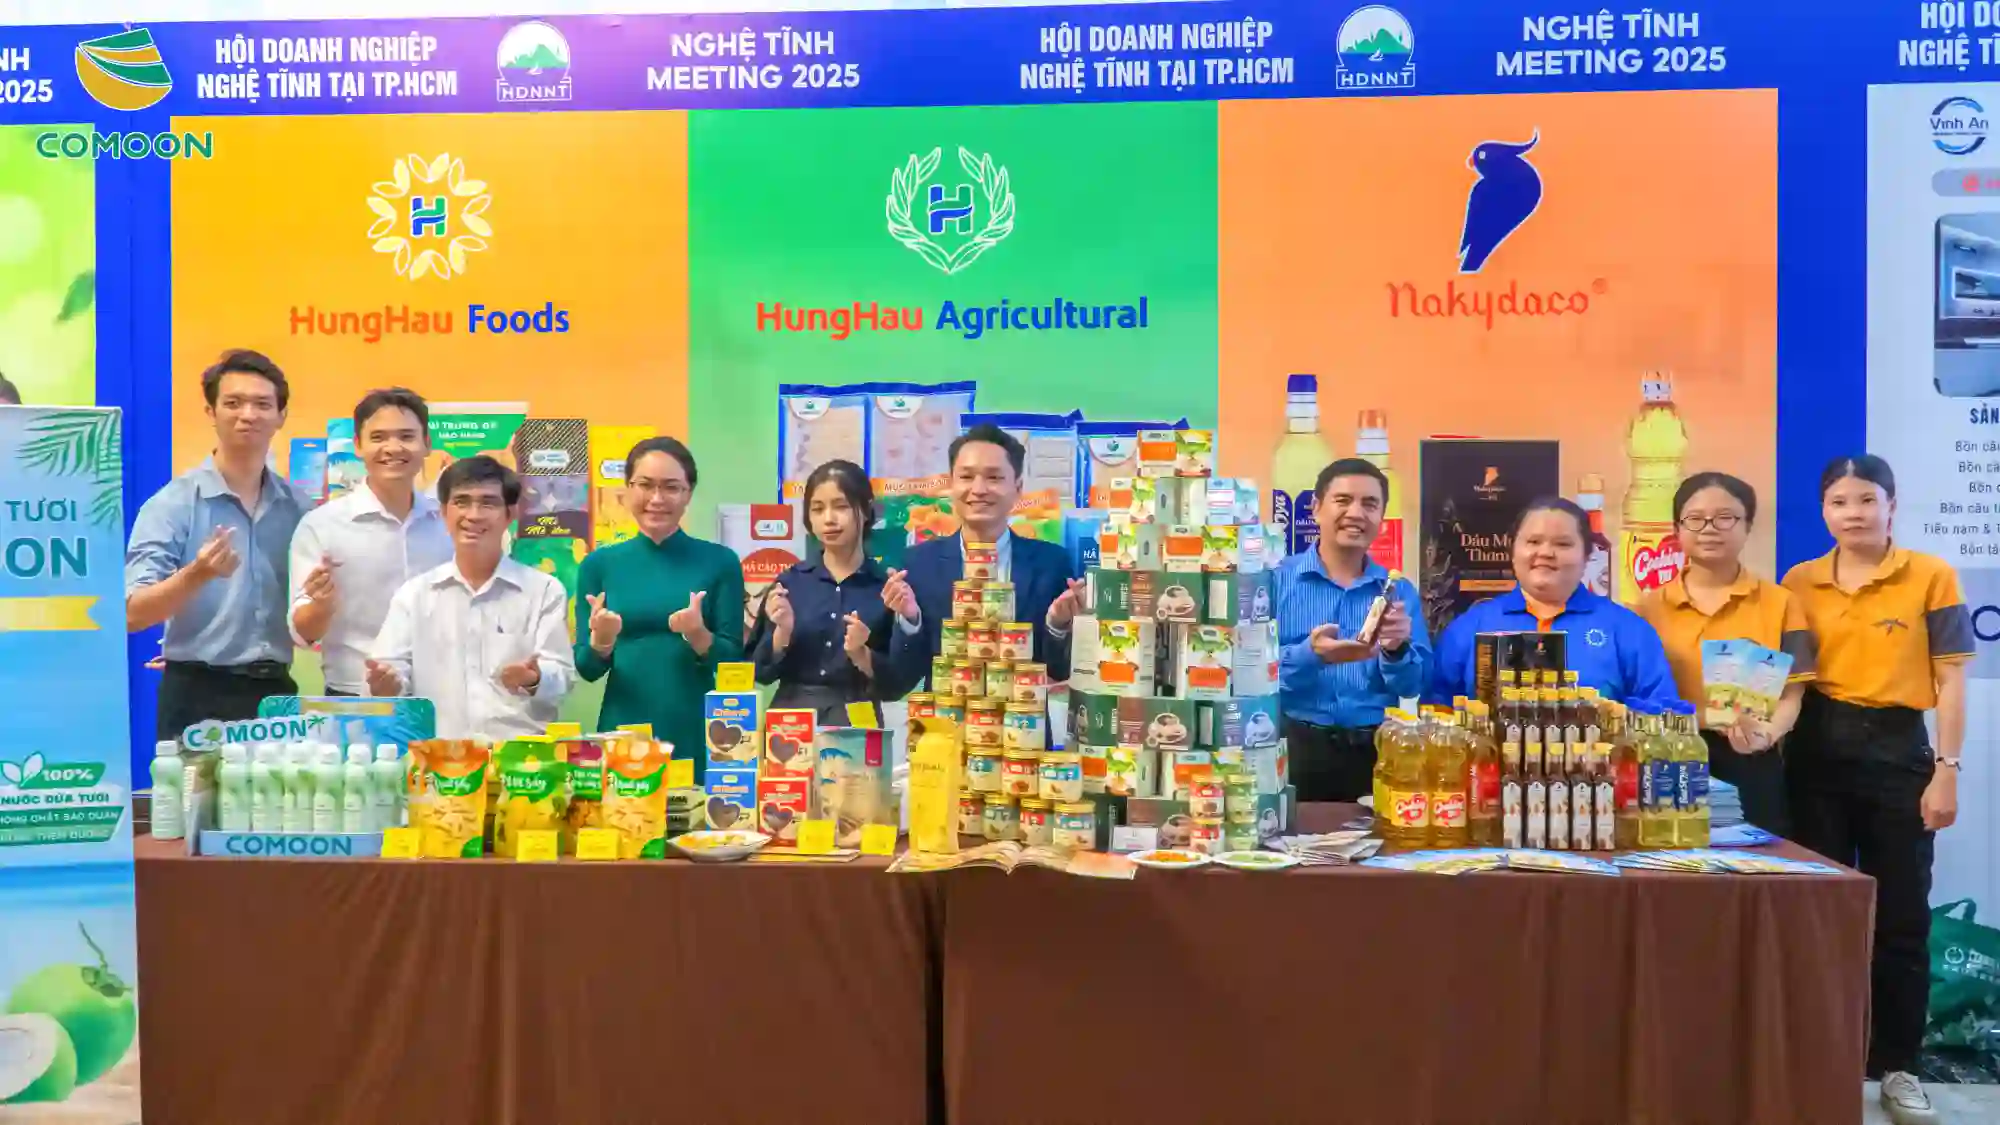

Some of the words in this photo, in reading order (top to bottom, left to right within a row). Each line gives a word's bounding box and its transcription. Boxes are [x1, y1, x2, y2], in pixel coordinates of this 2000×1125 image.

[1041, 22, 1080, 57] HỘI
[1089, 25, 1172, 51] DOANH
[1182, 16, 1272, 53] NGHIỆP
[1523, 9, 1613, 44] NGHỆ
[1623, 8, 1699, 38] TĨNH
[216, 34, 254, 68] HỘI
[263, 37, 342, 62] DOANH
[350, 31, 437, 66] NGHIỆP
[671, 27, 756, 62] NGHỆ
[764, 26, 833, 56] TĨNH
[1496, 51, 1642, 76] MEETING
[1653, 46, 1726, 71] 2025
[1899, 32, 1969, 72] NGHỆ
[197, 68, 260, 103] NGHỆ
[267, 68, 321, 97] TĨNH
[328, 72, 364, 102] TẠI
[372, 71, 457, 97] TP.HCM
[502, 84, 568, 100] HDNNT
[647, 66, 782, 90] MEETING
[792, 63, 860, 88] 2025
[1020, 57, 1085, 93] NGHỆ
[1094, 57, 1149, 87] TĨNH
[1158, 60, 1195, 91] TẠI
[1204, 57, 1293, 84] TP.HCM
[1341, 71, 1411, 86] HDNNT
[290, 304, 453, 343] HungHau
[469, 302, 569, 333] Foods
[756, 301, 922, 341] HungHau
[936, 296, 1148, 339] Agricultural
[6, 496, 77, 522] TƯƠI
[43, 768, 95, 781] 100%
[226, 836, 351, 856] COMOON
